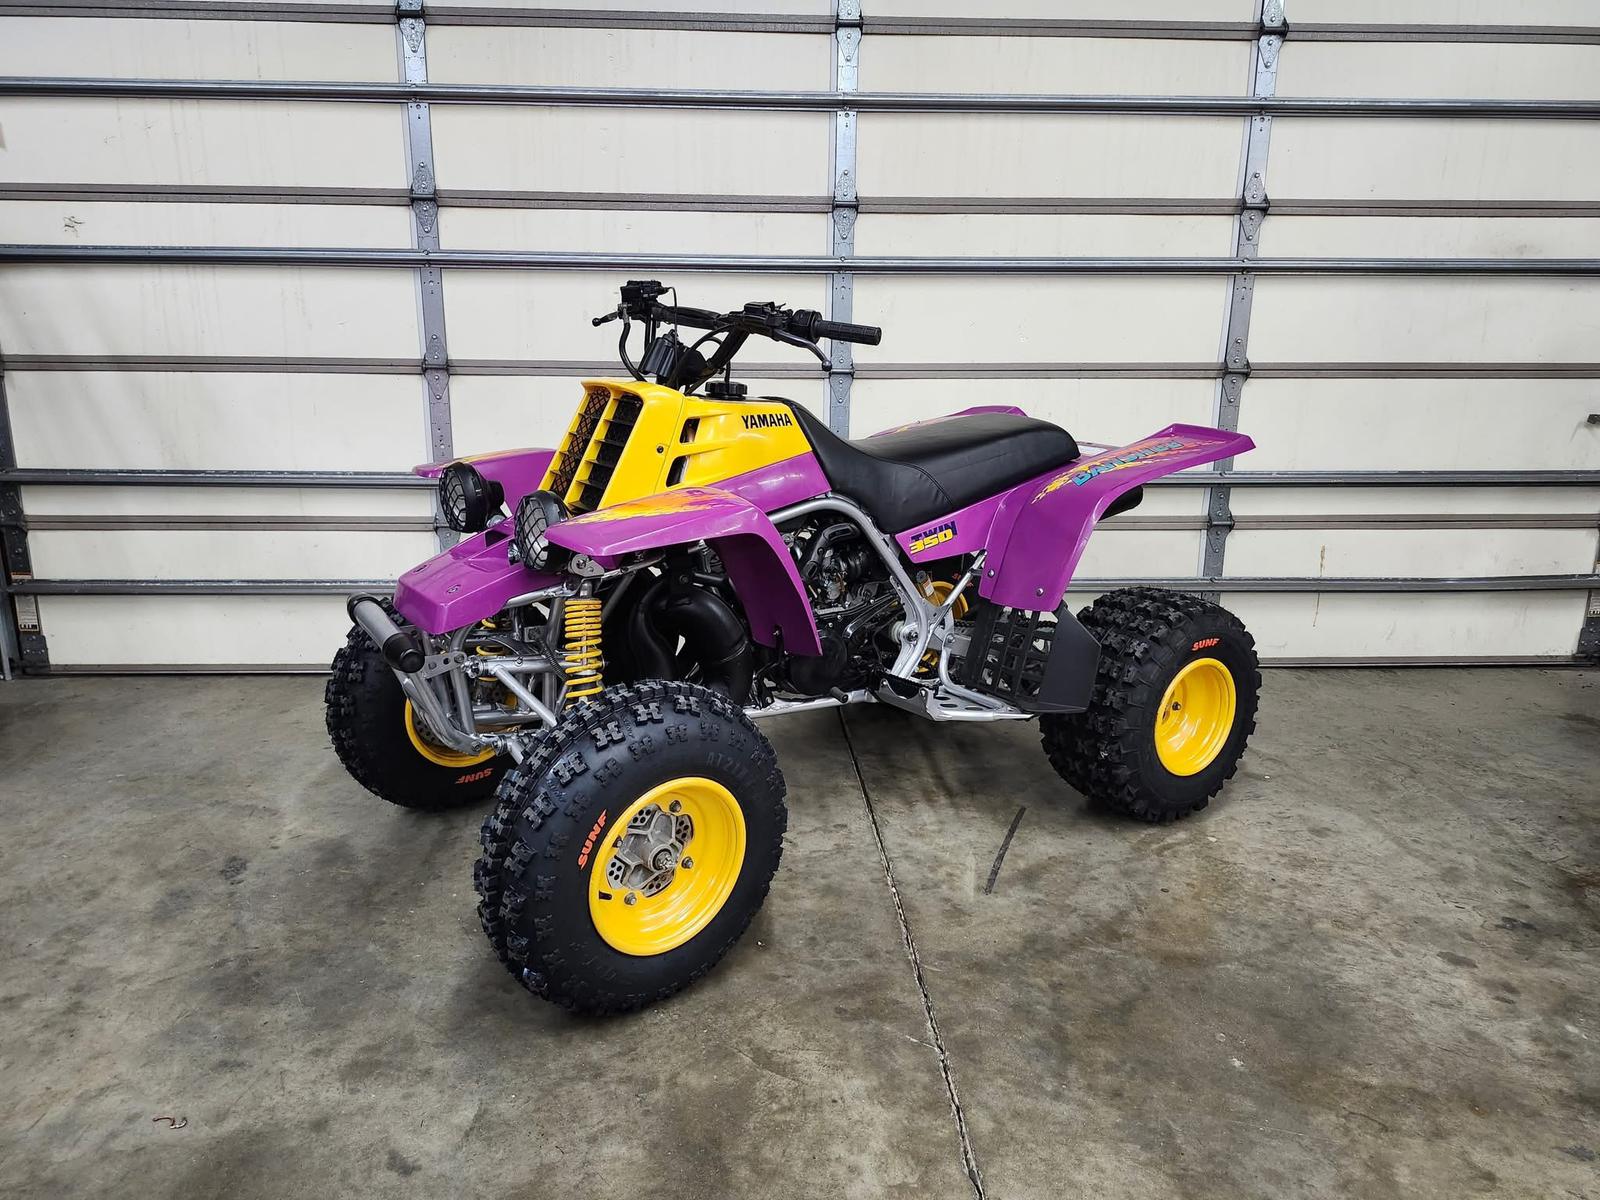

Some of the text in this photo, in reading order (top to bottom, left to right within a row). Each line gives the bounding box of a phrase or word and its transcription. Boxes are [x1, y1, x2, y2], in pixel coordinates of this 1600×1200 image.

[741, 413, 793, 429] YAMAHA
[910, 520, 958, 541] TWIN
[908, 528, 953, 554] 350
[1191, 638, 1220, 651] SUNF
[454, 767, 494, 784] SUNF
[578, 808, 607, 870] SUNF
